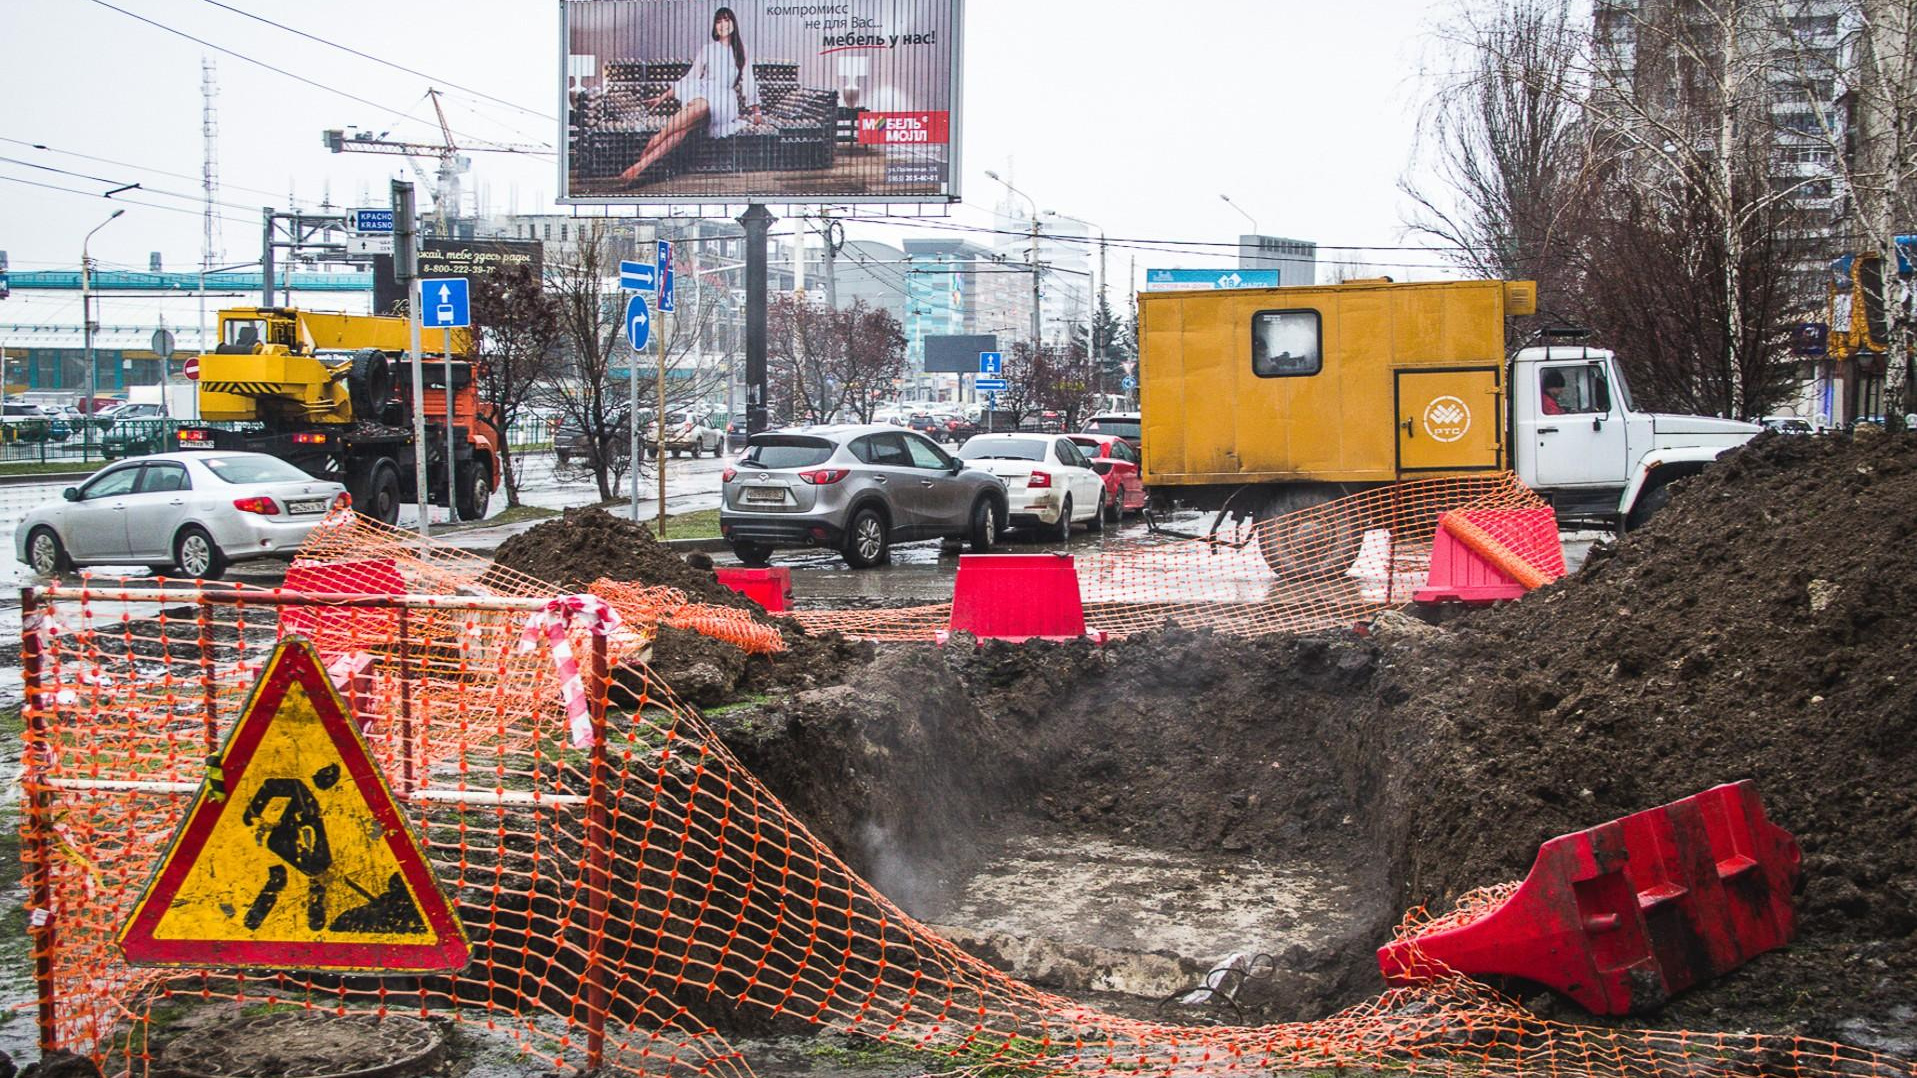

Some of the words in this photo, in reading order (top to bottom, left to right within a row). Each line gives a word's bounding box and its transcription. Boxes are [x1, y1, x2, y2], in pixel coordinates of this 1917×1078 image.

[767, 4, 849, 18] компромисс
[805, 20, 821, 30] не
[824, 20, 848, 32] для
[851, 17, 883, 29] Вас...
[822, 32, 885, 47] мебель
[889, 35, 899, 49] у
[902, 31, 936, 45] нас!
[885, 130, 928, 142] МОЛЛ
[446, 249, 473, 260] тебе
[472, 253, 501, 264] здесь
[503, 253, 531, 265] рады
[1223, 279, 1234, 288] 18
